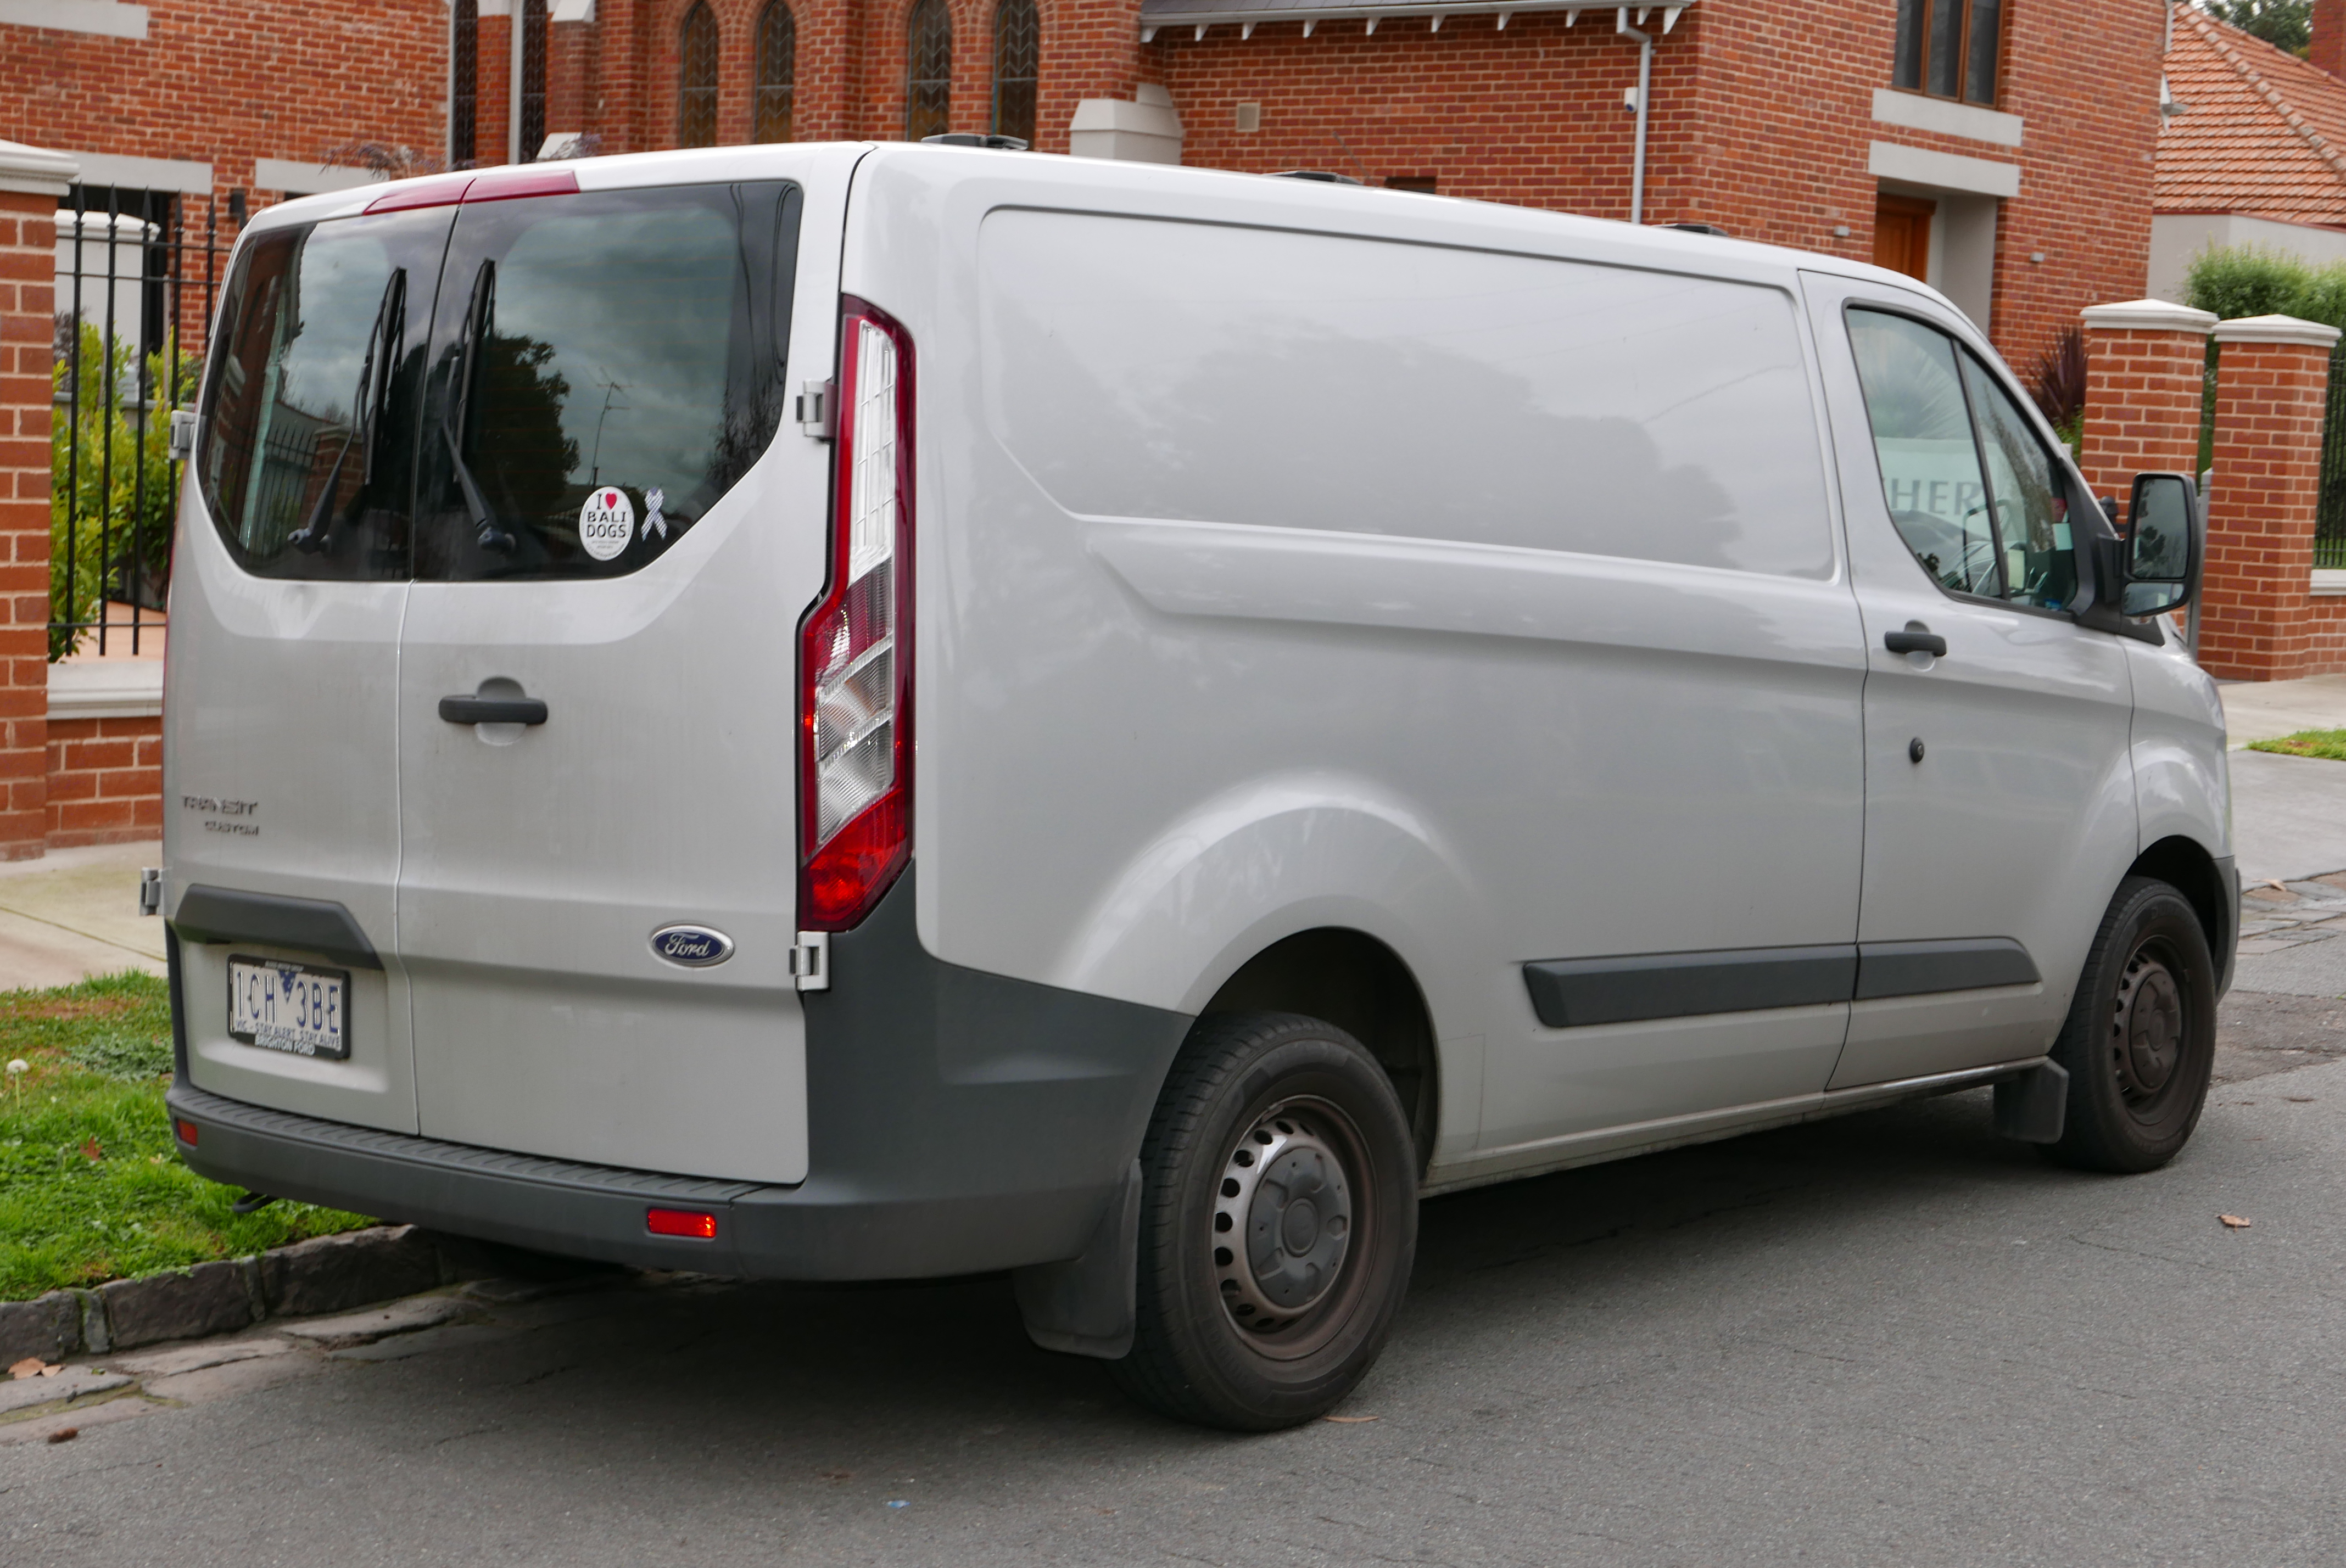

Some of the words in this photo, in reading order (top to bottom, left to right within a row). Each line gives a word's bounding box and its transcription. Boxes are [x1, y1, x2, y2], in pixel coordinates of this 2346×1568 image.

[596, 494, 602, 509] I
[587, 512, 627, 523] BALI
[587, 524, 627, 538] DOGS
[664, 933, 711, 957] Ford
[293, 1041, 315, 1056] FORD
